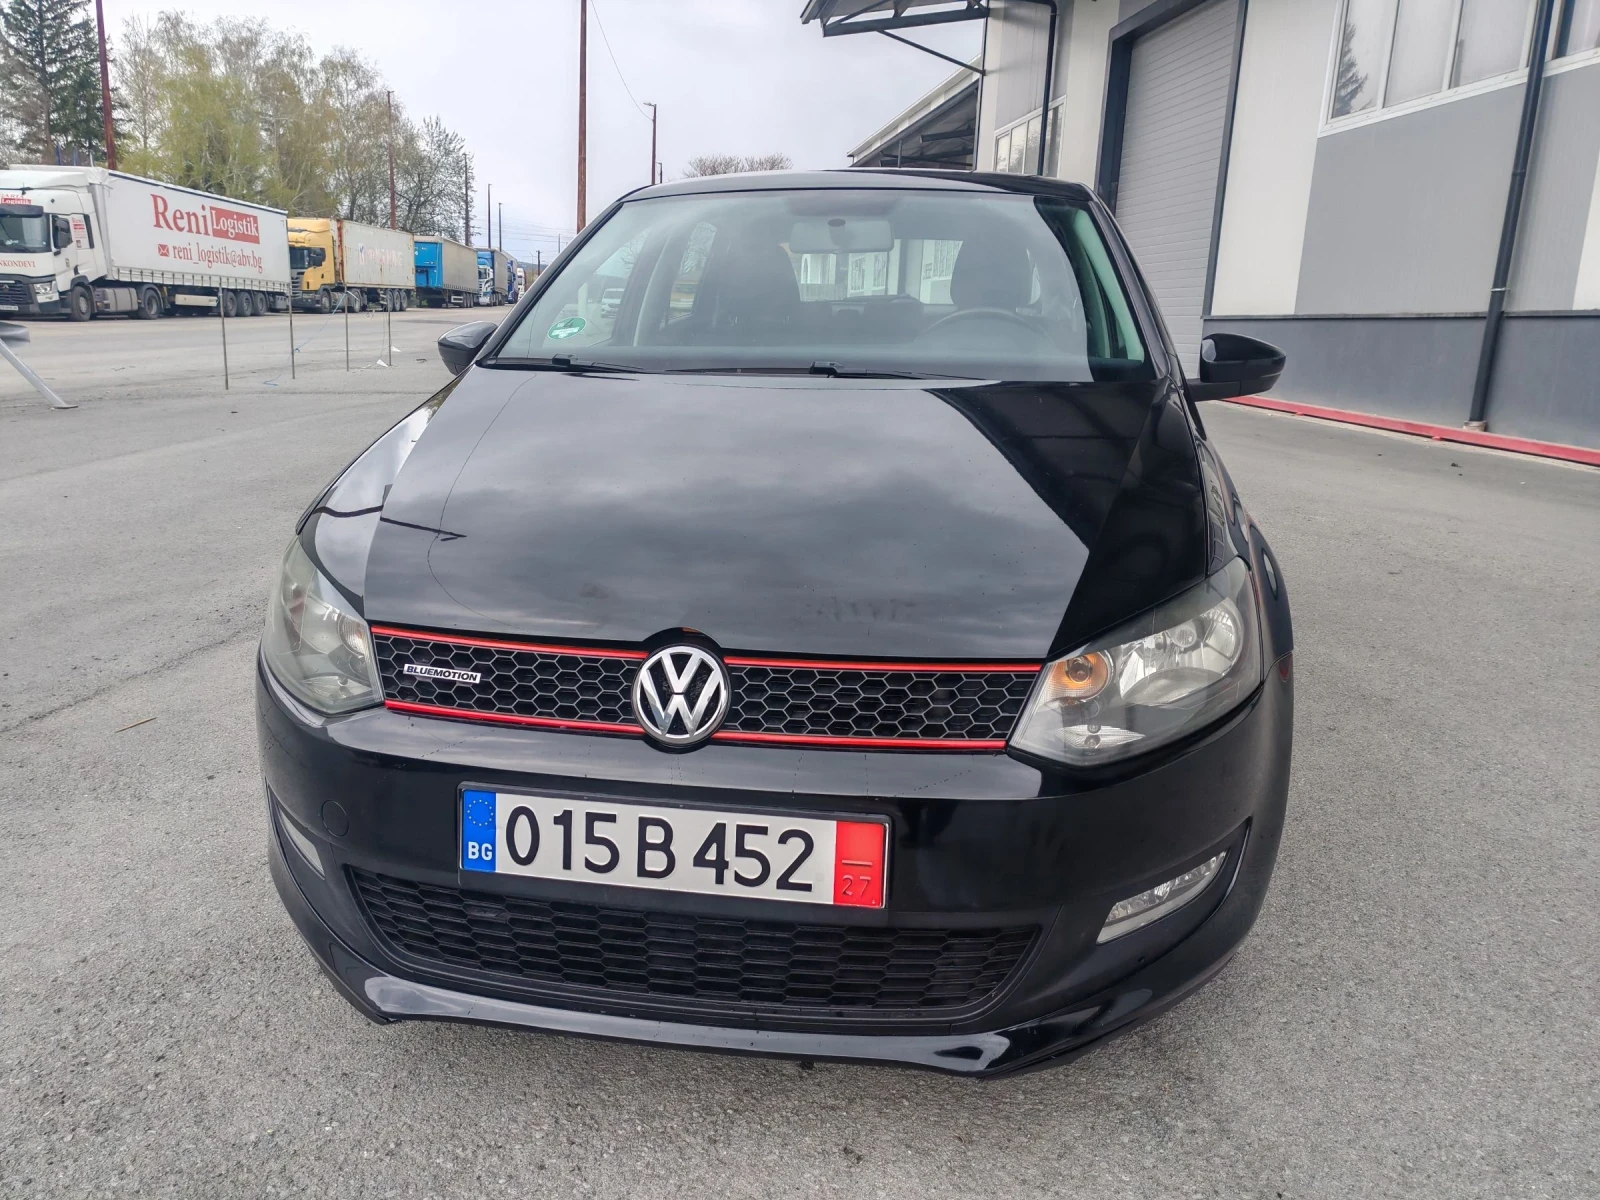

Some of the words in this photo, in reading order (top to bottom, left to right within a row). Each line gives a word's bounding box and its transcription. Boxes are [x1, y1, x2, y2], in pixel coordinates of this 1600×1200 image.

[150, 194, 210, 236] Reni
[211, 210, 259, 238] Logistik
[172, 242, 263, 274] reni_logistik@abv.bg
[406, 665, 478, 681] BLUEMOTION
[468, 841, 493, 861] BG
[842, 874, 872, 896] 27
